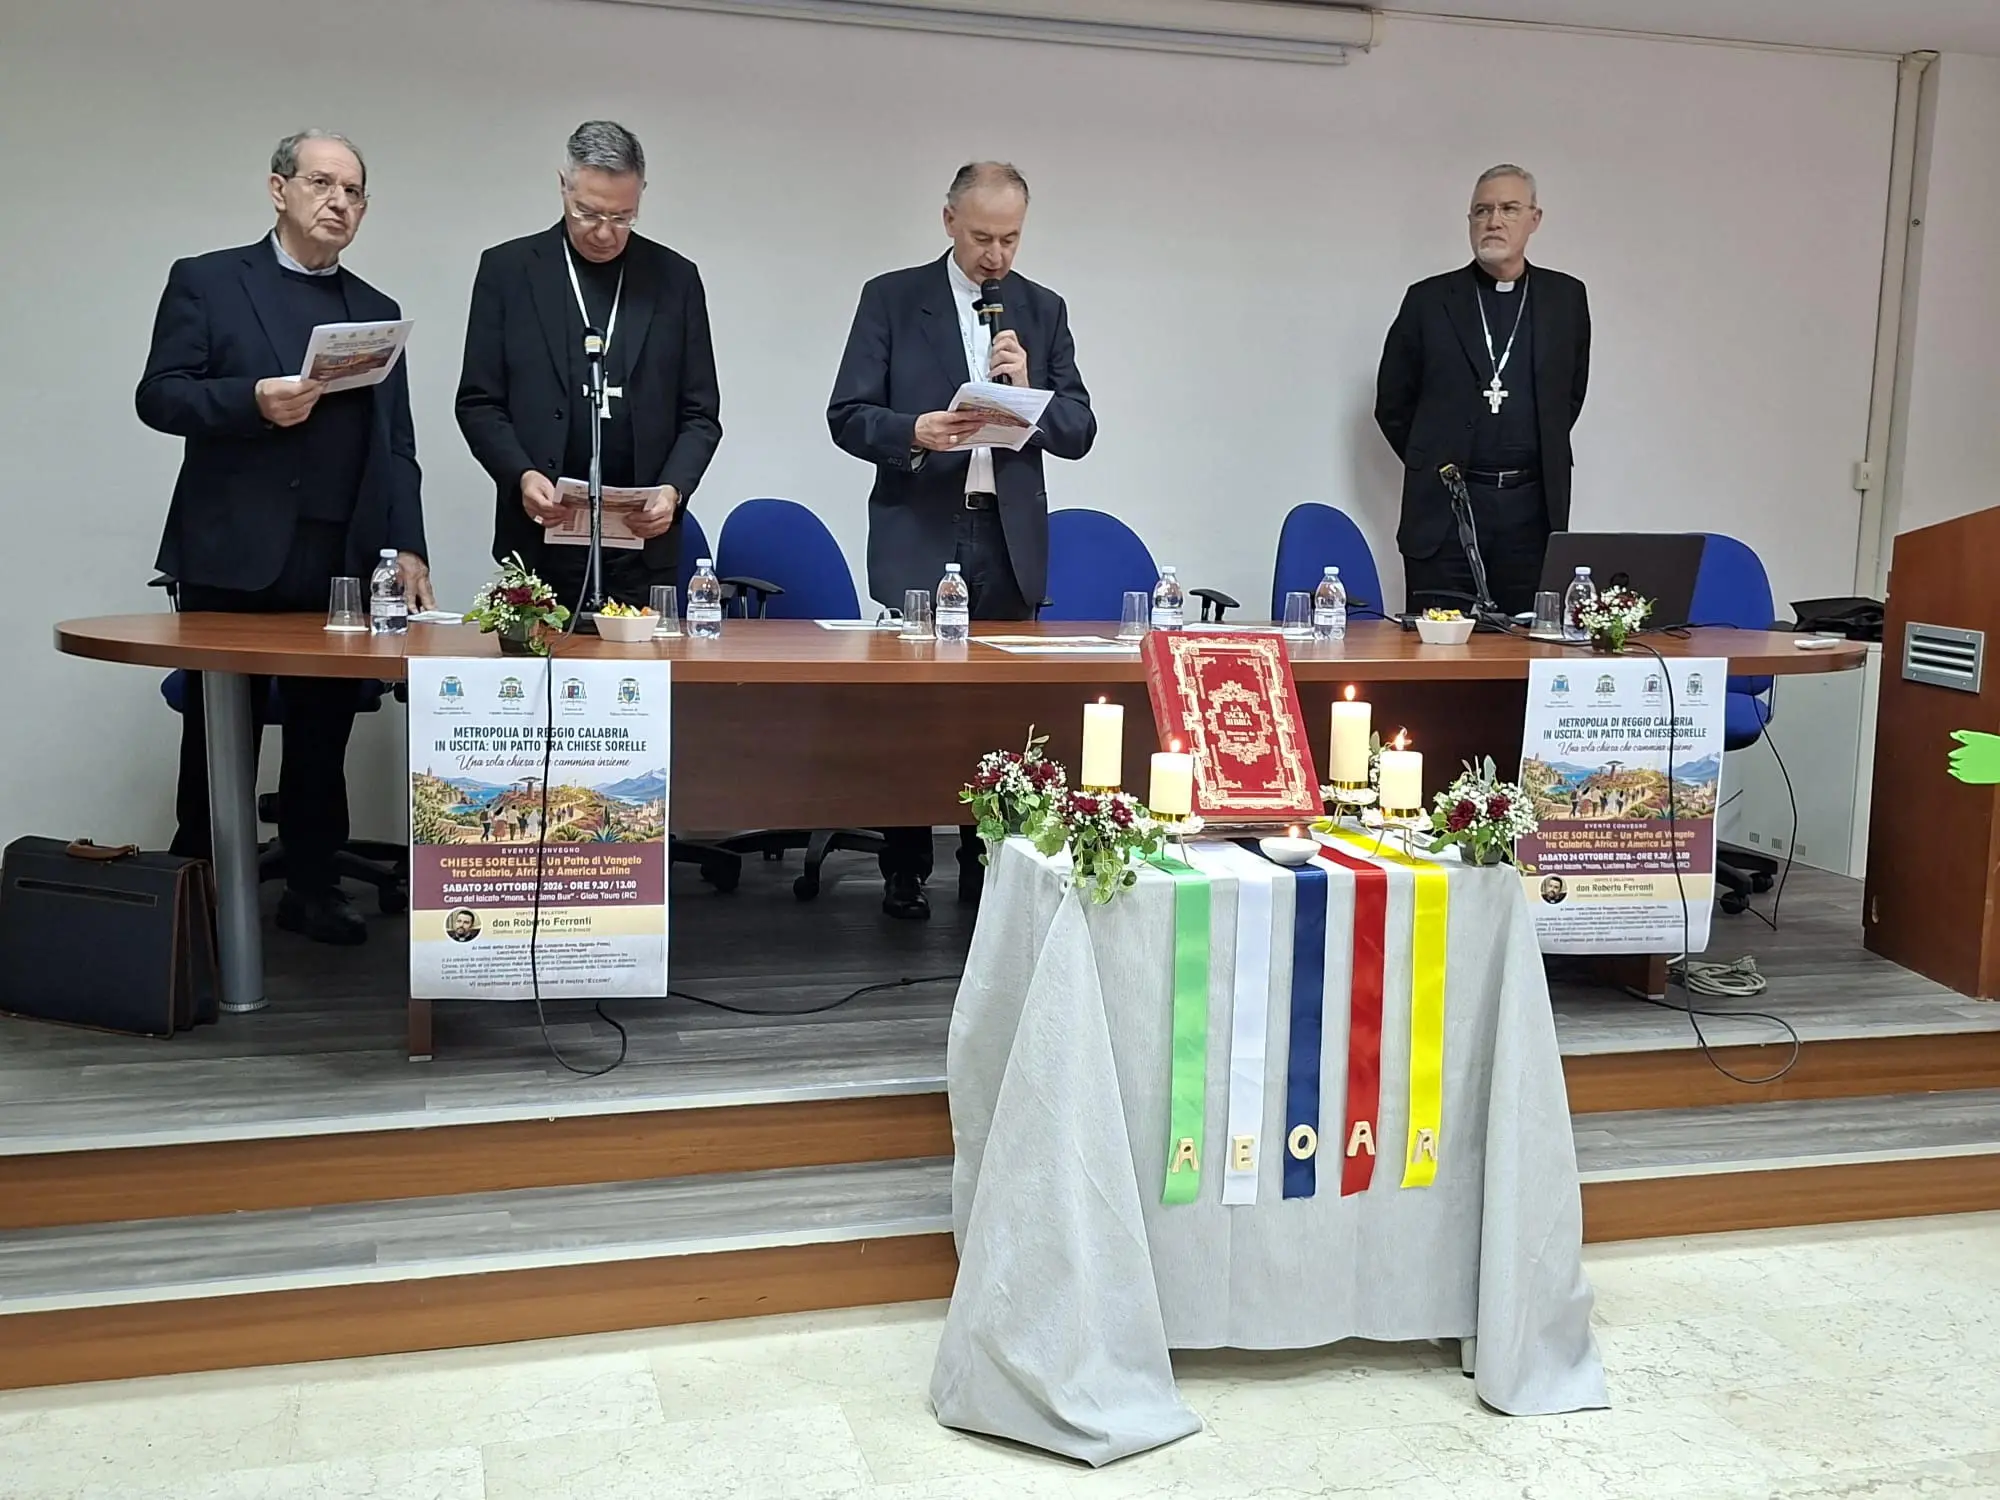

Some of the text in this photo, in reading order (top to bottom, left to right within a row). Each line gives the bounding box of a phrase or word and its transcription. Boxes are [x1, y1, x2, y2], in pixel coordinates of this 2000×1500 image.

[1559, 717, 1608, 728] METROPOLIA
[1611, 717, 1620, 727] DI
[1622, 716, 1652, 726] REGGIO
[454, 727, 519, 738] METROPOLIA
[522, 727, 534, 738] DI
[578, 727, 629, 738] CALABRIA
[1544, 730, 1552, 739] IN
[1554, 729, 1584, 739] USCITA:
[1588, 729, 1598, 738] UN
[1601, 728, 1624, 738] PATTO
[1627, 728, 1642, 738] TRA
[434, 740, 446, 752] IN
[450, 740, 488, 752] USCITA:
[492, 740, 506, 752] UN
[510, 740, 540, 752] PATTO
[567, 740, 602, 752] CHIESE
[605, 740, 646, 752] SORELLE
[456, 754, 482, 770] Una
[485, 754, 504, 766] sola
[506, 754, 534, 766] chiesa
[554, 756, 594, 766] cammina
[597, 756, 631, 766] insieme
[1536, 832, 1570, 840] CHIESE
[1572, 832, 1612, 840] SORELLE
[440, 856, 642, 868] CHIESE SORELLE Un Patto di Vangelo
[452, 869, 466, 878] tra
[469, 868, 514, 878] Calabria,
[548, 868, 554, 876] e
[556, 867, 597, 876] America
[600, 866, 630, 875] Latina
[442, 884, 482, 892] SABATO
[482, 883, 493, 892] 24
[544, 882, 563, 890] 2026
[570, 881, 590, 890] ORE
[464, 894, 475, 902] del
[622, 892, 638, 900] (RC)
[492, 919, 510, 928] don
[1288, 1124, 1318, 1160] O
[1346, 1120, 1376, 1156] A
[1232, 1134, 1255, 1170] E
[1411, 1128, 1438, 1164] A
[1170, 1137, 1200, 1173] A
